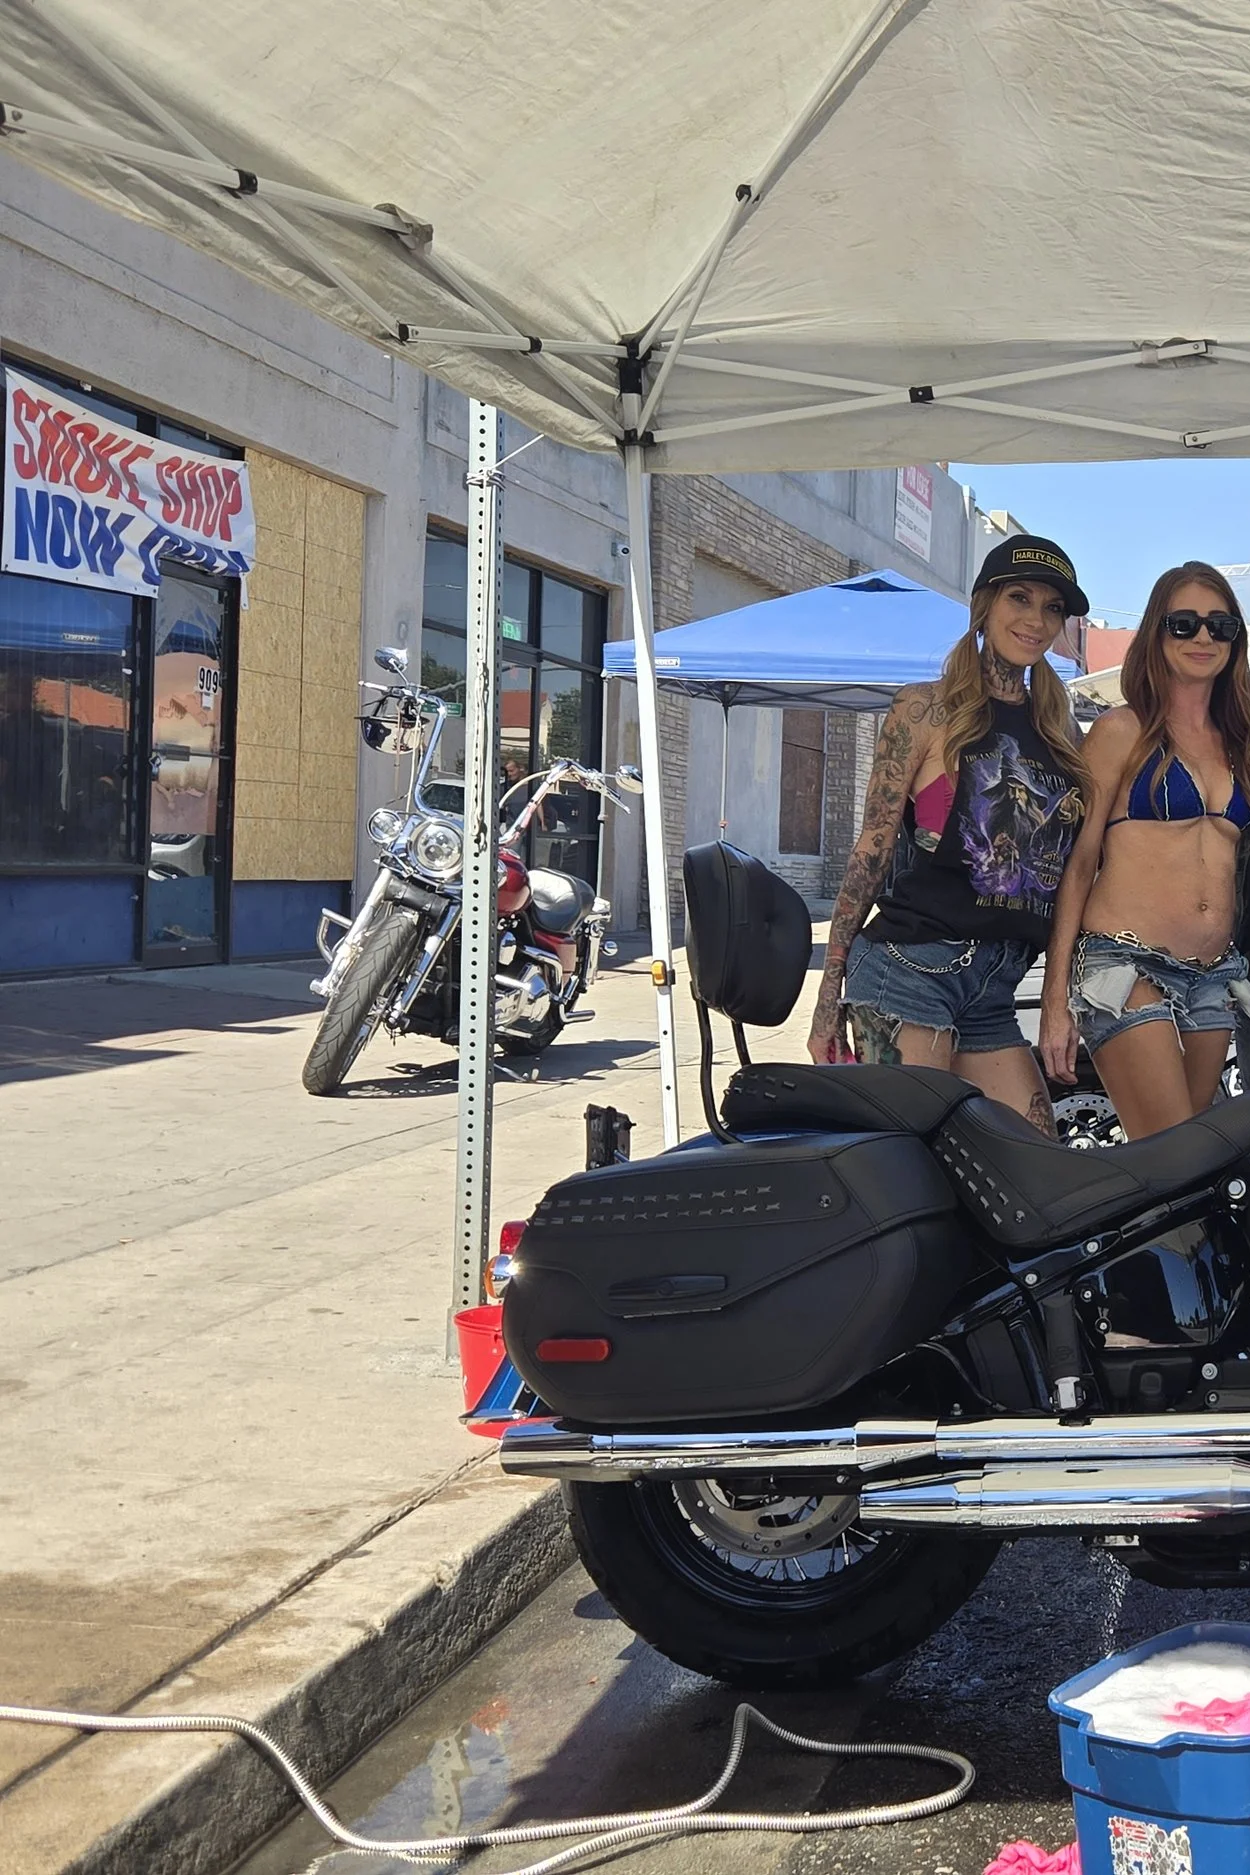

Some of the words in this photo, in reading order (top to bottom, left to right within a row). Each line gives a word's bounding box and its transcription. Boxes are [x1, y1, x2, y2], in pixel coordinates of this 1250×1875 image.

[12, 388, 154, 511] SMOKE
[156, 456, 242, 542] SHOP
[14, 486, 136, 577] NOW
[199, 667, 222, 693] 909
